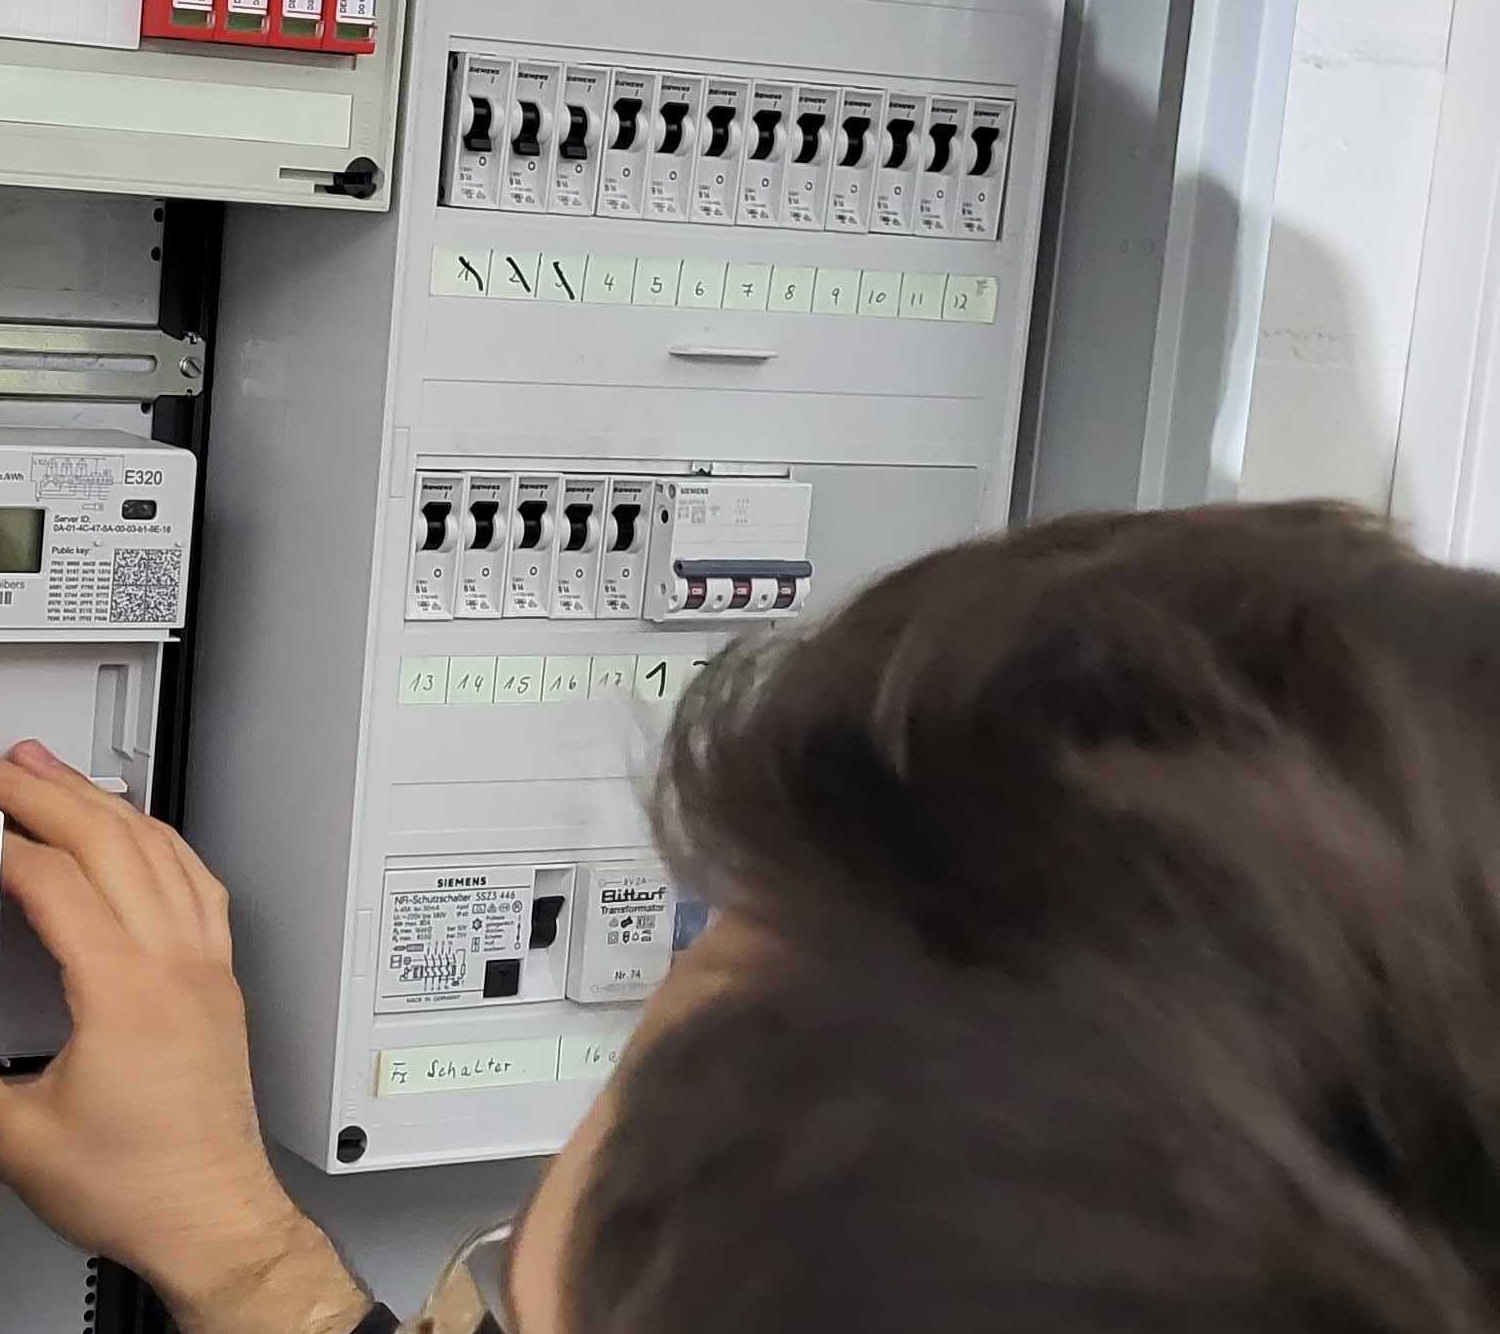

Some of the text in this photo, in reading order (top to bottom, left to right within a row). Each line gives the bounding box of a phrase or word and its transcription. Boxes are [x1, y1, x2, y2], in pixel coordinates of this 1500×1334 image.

[604, 273, 614, 291] 4
[651, 276, 663, 293] 5
[695, 281, 704, 296] 6
[741, 283, 753, 297] 7
[784, 284, 796, 300] 8
[831, 287, 840, 305] 9
[868, 290, 886, 304] 10
[911, 293, 923, 306] 11
[953, 293, 968, 310] 12
[124, 470, 163, 485] E320
[680, 487, 709, 495] SIEMENS
[51, 546, 74, 555] Public
[409, 672, 434, 692] 13
[457, 674, 484, 692] 14
[503, 675, 531, 694] 15
[550, 675, 577, 692] 16
[599, 672, 623, 687] 17
[437, 876, 487, 888] SIEMENS
[601, 905, 665, 915] Transformator
[615, 970, 628, 979] Nr.
